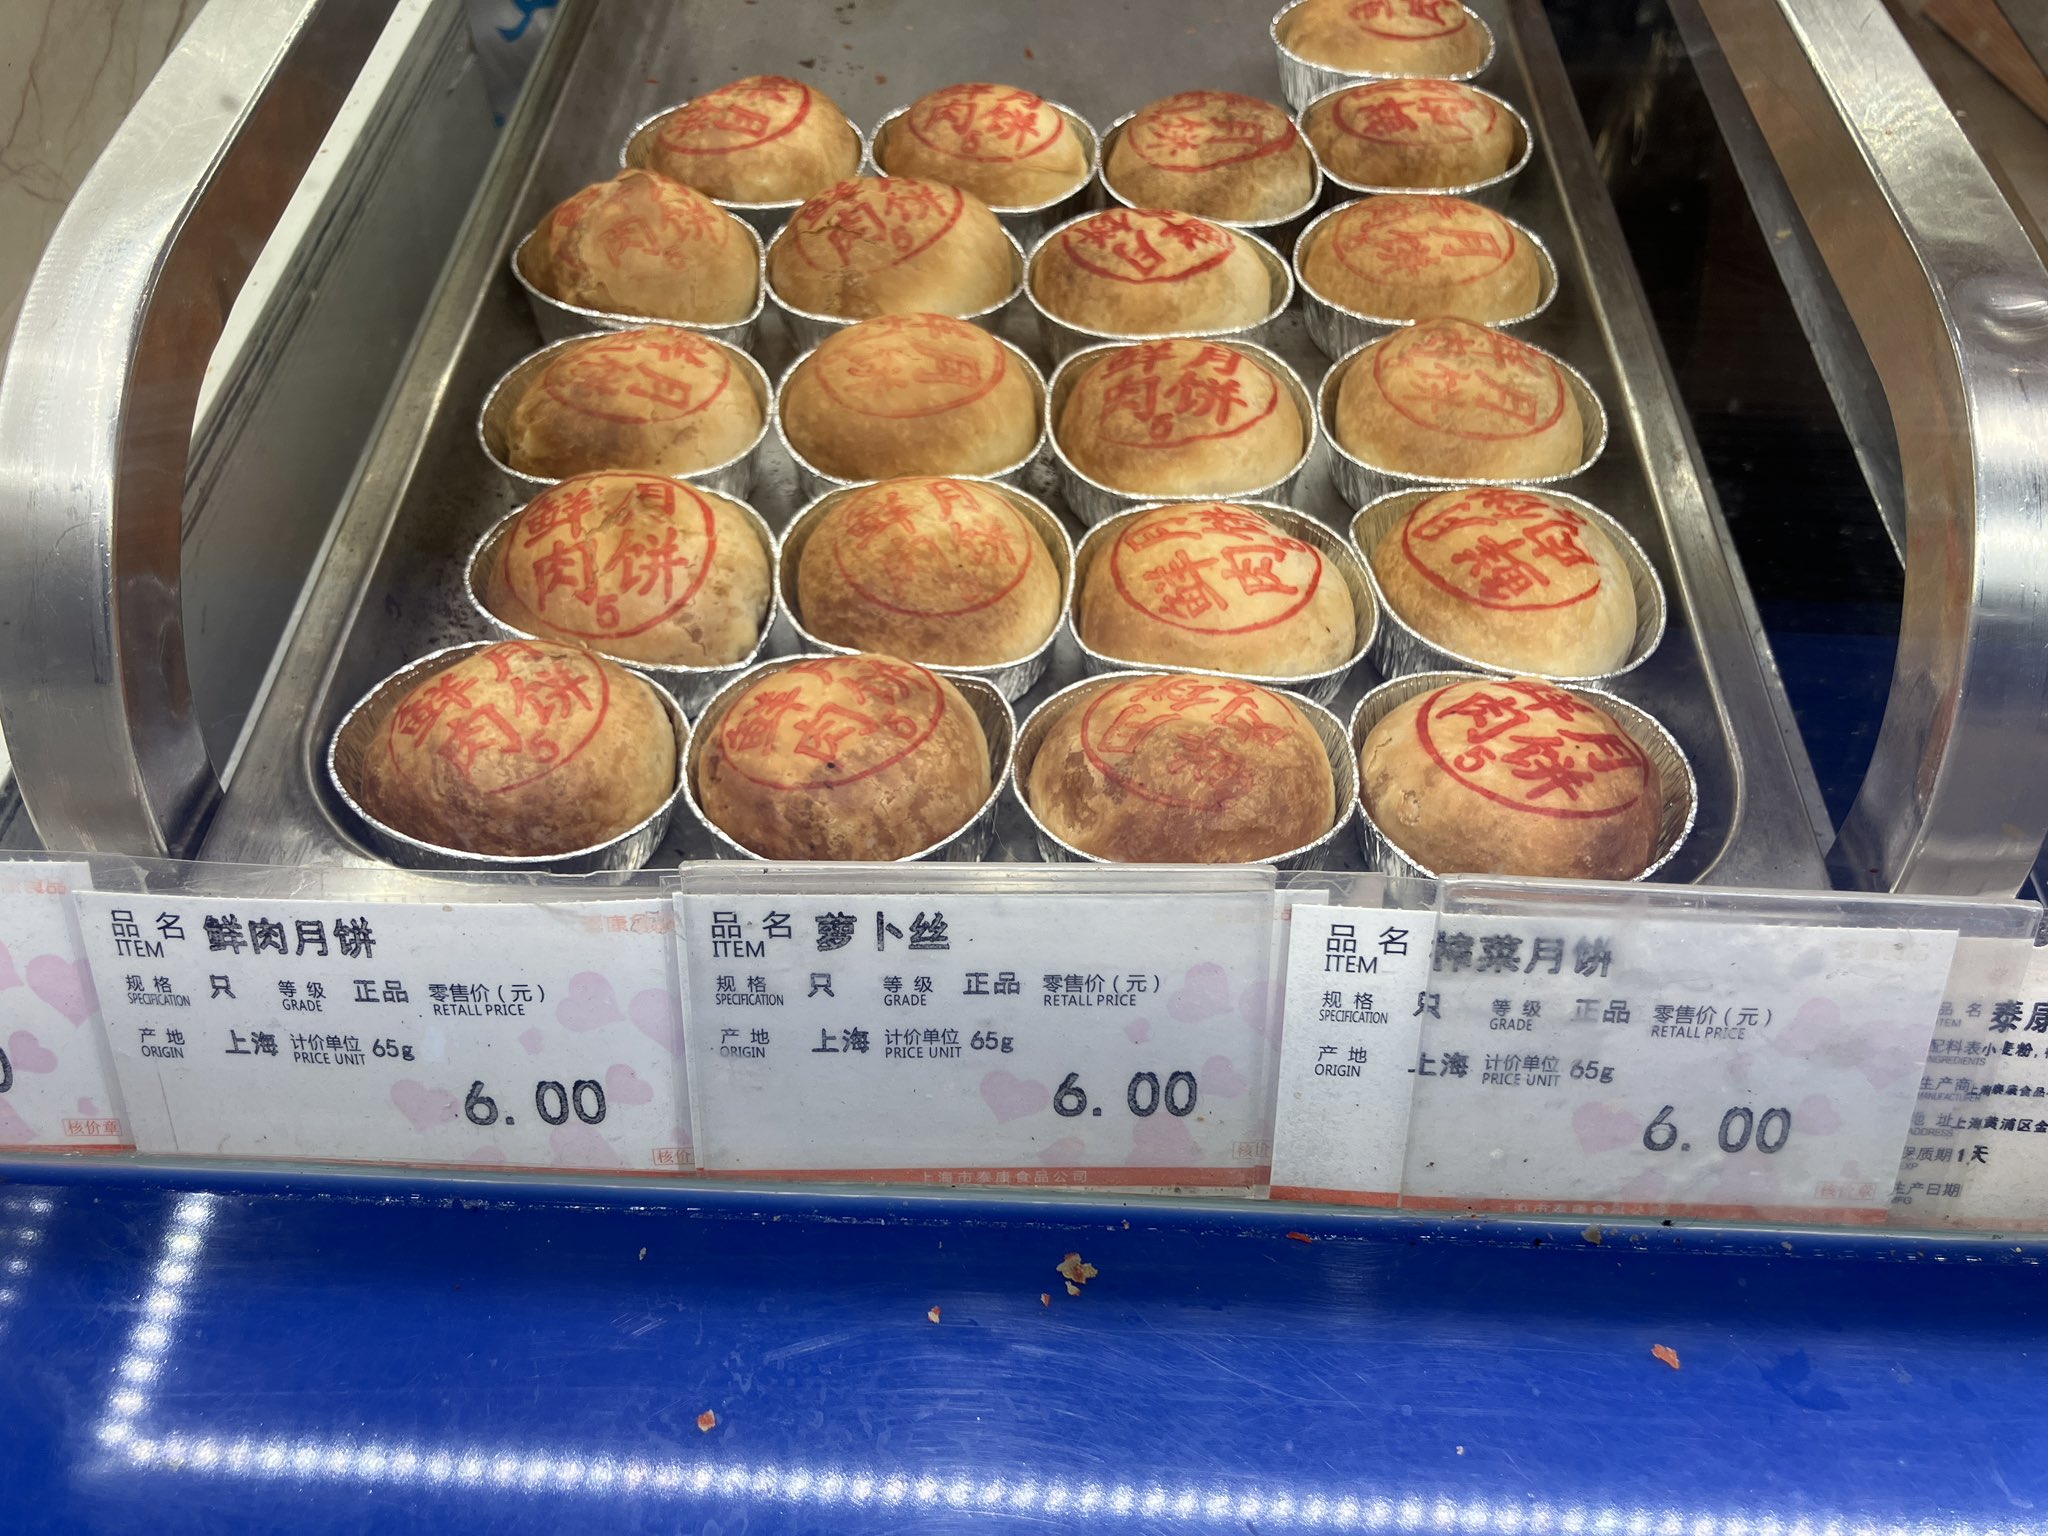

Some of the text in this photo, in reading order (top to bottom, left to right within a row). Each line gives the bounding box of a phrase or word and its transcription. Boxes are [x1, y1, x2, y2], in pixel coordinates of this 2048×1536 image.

[111, 909, 376, 958] 品名 鲜肉月饼
[711, 910, 792, 940] 品名
[815, 911, 950, 952] 萝卜丝
[114, 938, 165, 958] ITEM
[713, 941, 765, 958] ITEM
[1326, 924, 1612, 977] 品名 榨菜月饼
[1324, 955, 1378, 974] ITEM
[126, 974, 172, 993] 规格
[209, 974, 236, 999] 只
[278, 980, 326, 998] 等级
[353, 980, 410, 1003] 正品
[717, 975, 767, 993] 规格
[808, 973, 835, 997] 只
[883, 976, 934, 993] 等级
[963, 972, 1021, 995] 正品
[127, 993, 191, 1007] SPECIFICATION
[282, 999, 323, 1012] GRADE
[715, 994, 784, 1006] SPECIFICATION
[884, 994, 927, 1006] GRADE
[1043, 995, 1136, 1006] RETALL PRICE
[433, 1004, 526, 1016] RETALL PRICE
[1321, 991, 1373, 1010] 规格
[1413, 991, 1440, 1019] 只
[1491, 999, 1541, 1018] 等级
[1570, 998, 1630, 1024] 正品
[1318, 1010, 1388, 1024] SPECIFICATION
[1489, 1018, 1533, 1031] GRADE
[1651, 1026, 1746, 1039] RETALL PRICE
[139, 1028, 415, 1061] 产地 上海 计价单位 65g
[720, 1027, 1014, 1053] 产地 上海 计价单位 65g
[141, 1045, 184, 1058] ORIGIN
[294, 1052, 365, 1065] PRICE UNIT
[720, 1046, 765, 1058] ORIGIN
[885, 1046, 962, 1058] PRICE UNIT
[1314, 1064, 1361, 1077] ORIGIN
[1317, 1045, 1615, 1084] 产地 上海 计价单位 65g
[1482, 1073, 1561, 1087] PRICE UNIT
